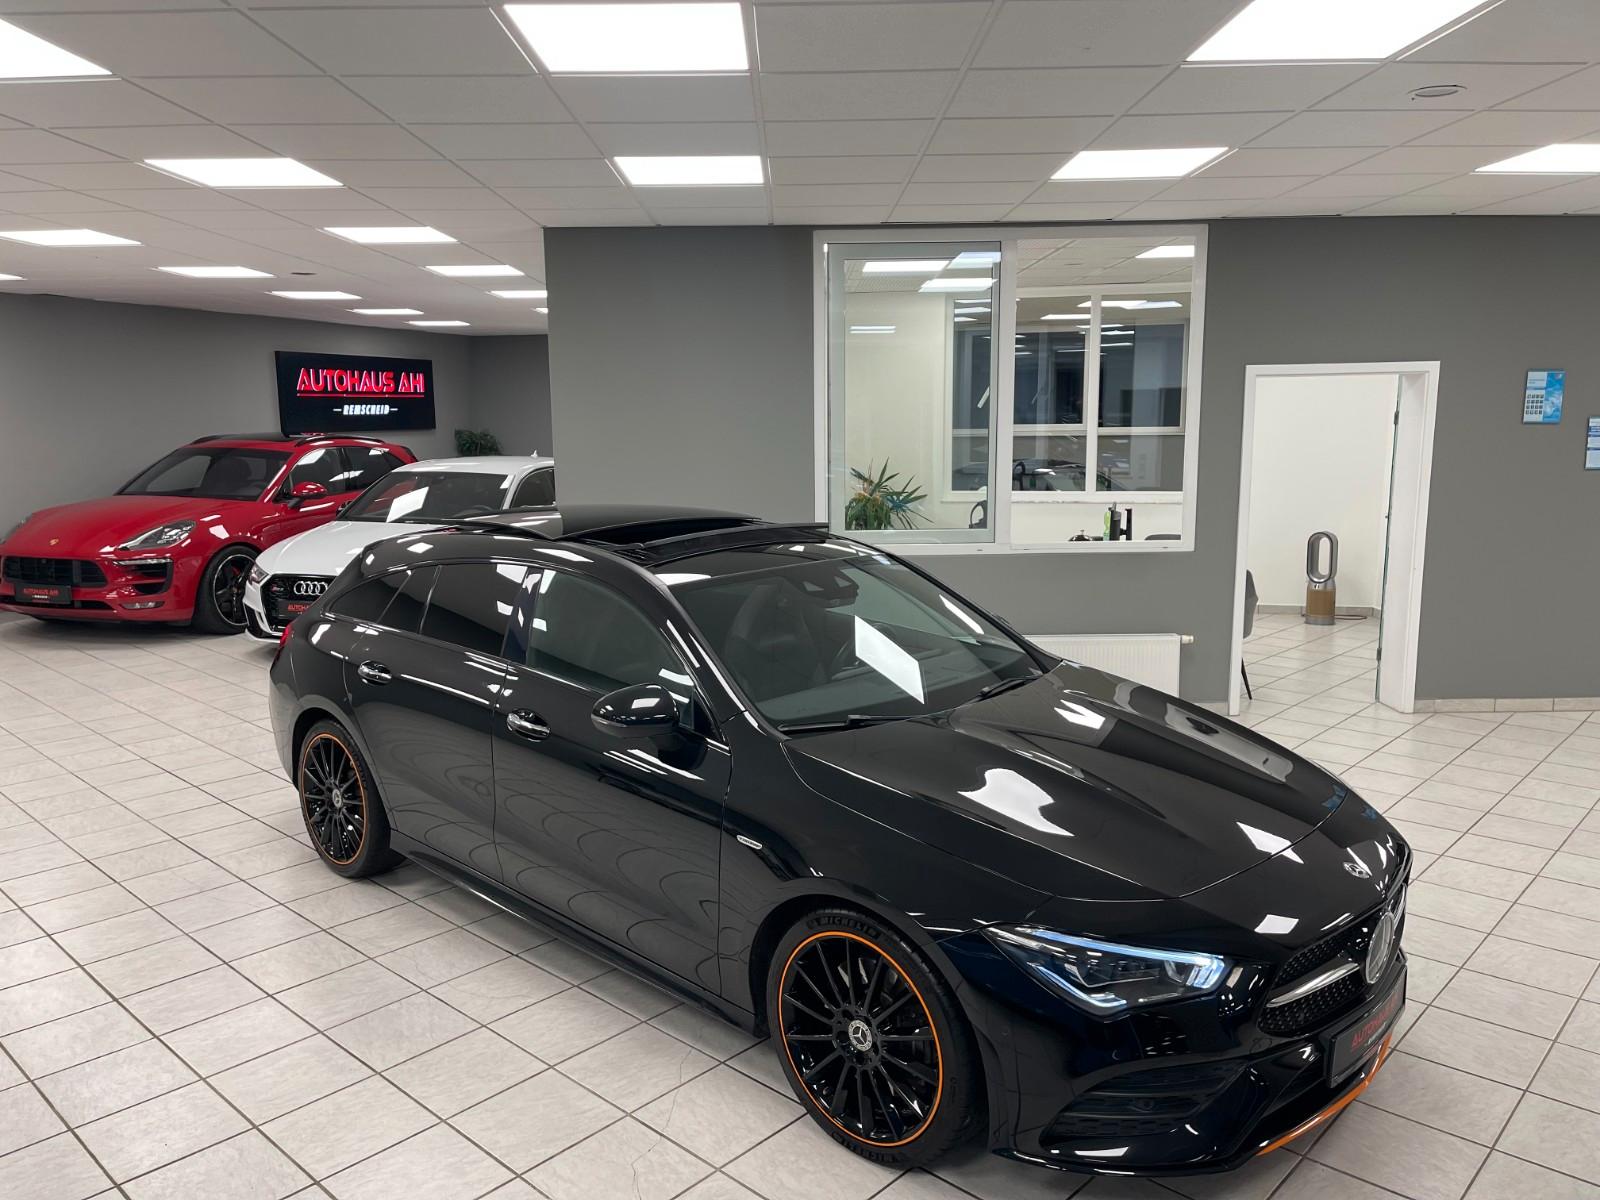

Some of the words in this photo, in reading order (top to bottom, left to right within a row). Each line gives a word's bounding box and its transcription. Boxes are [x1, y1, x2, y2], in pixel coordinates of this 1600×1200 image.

[296, 367, 396, 393] AUTOHAUS
[398, 372, 425, 393] AHI
[343, 404, 390, 415] REMSCHEID
